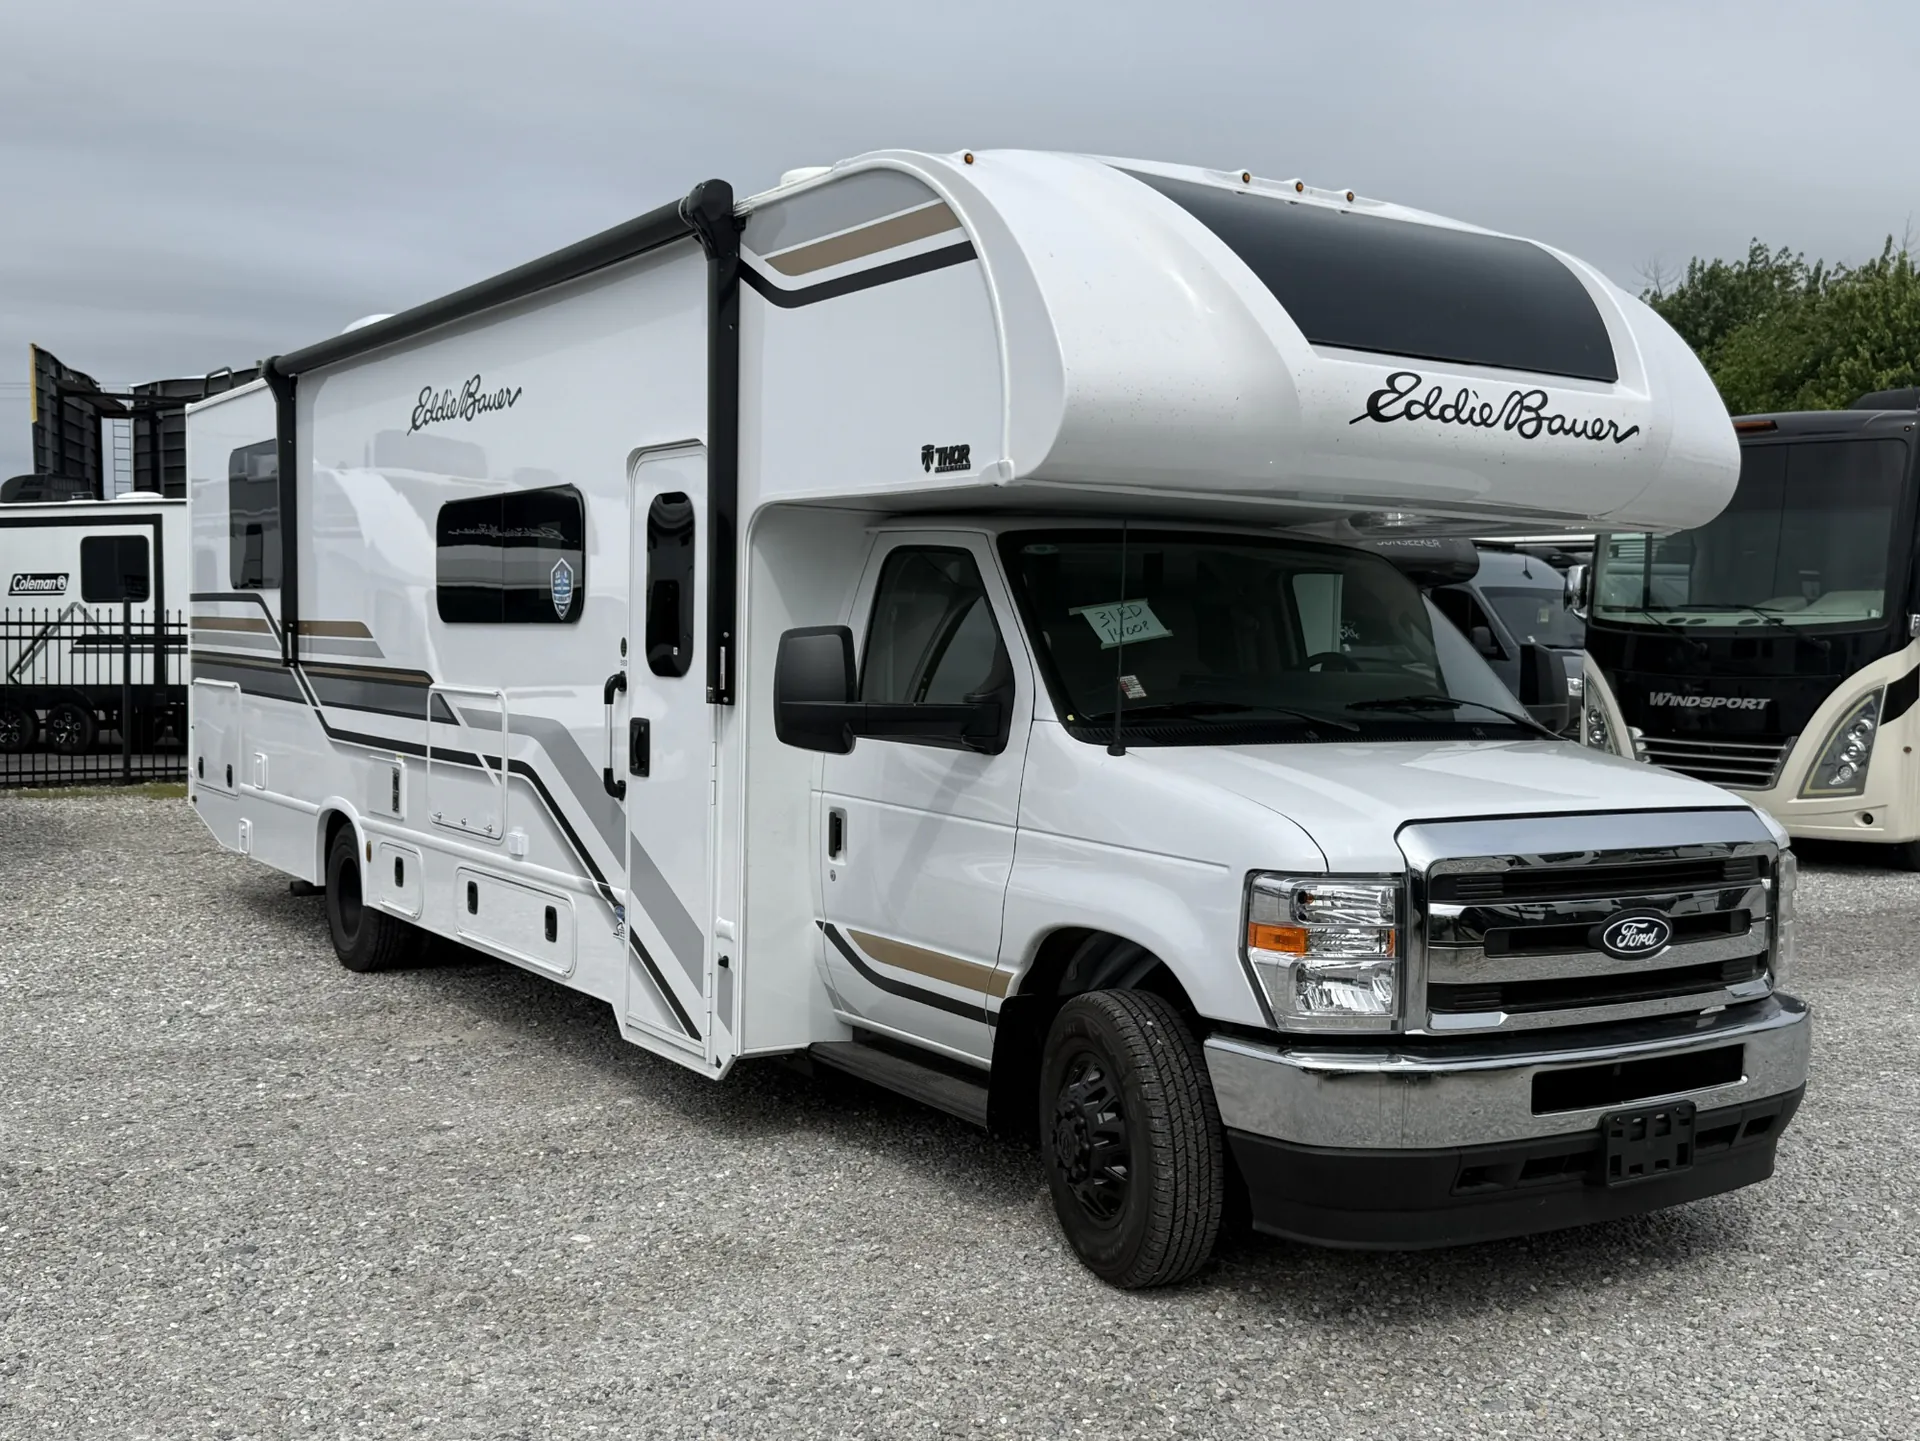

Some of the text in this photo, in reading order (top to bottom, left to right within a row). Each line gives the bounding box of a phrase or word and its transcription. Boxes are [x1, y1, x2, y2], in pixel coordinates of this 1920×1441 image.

[406, 373, 522, 436] Eddie Bauer
[1349, 371, 1640, 444] Eddie Bauer
[935, 444, 971, 466] THOR
[12, 575, 57, 591] Coleman
[1649, 691, 1771, 710] WINDSPORT
[1616, 922, 1658, 948] Ford
